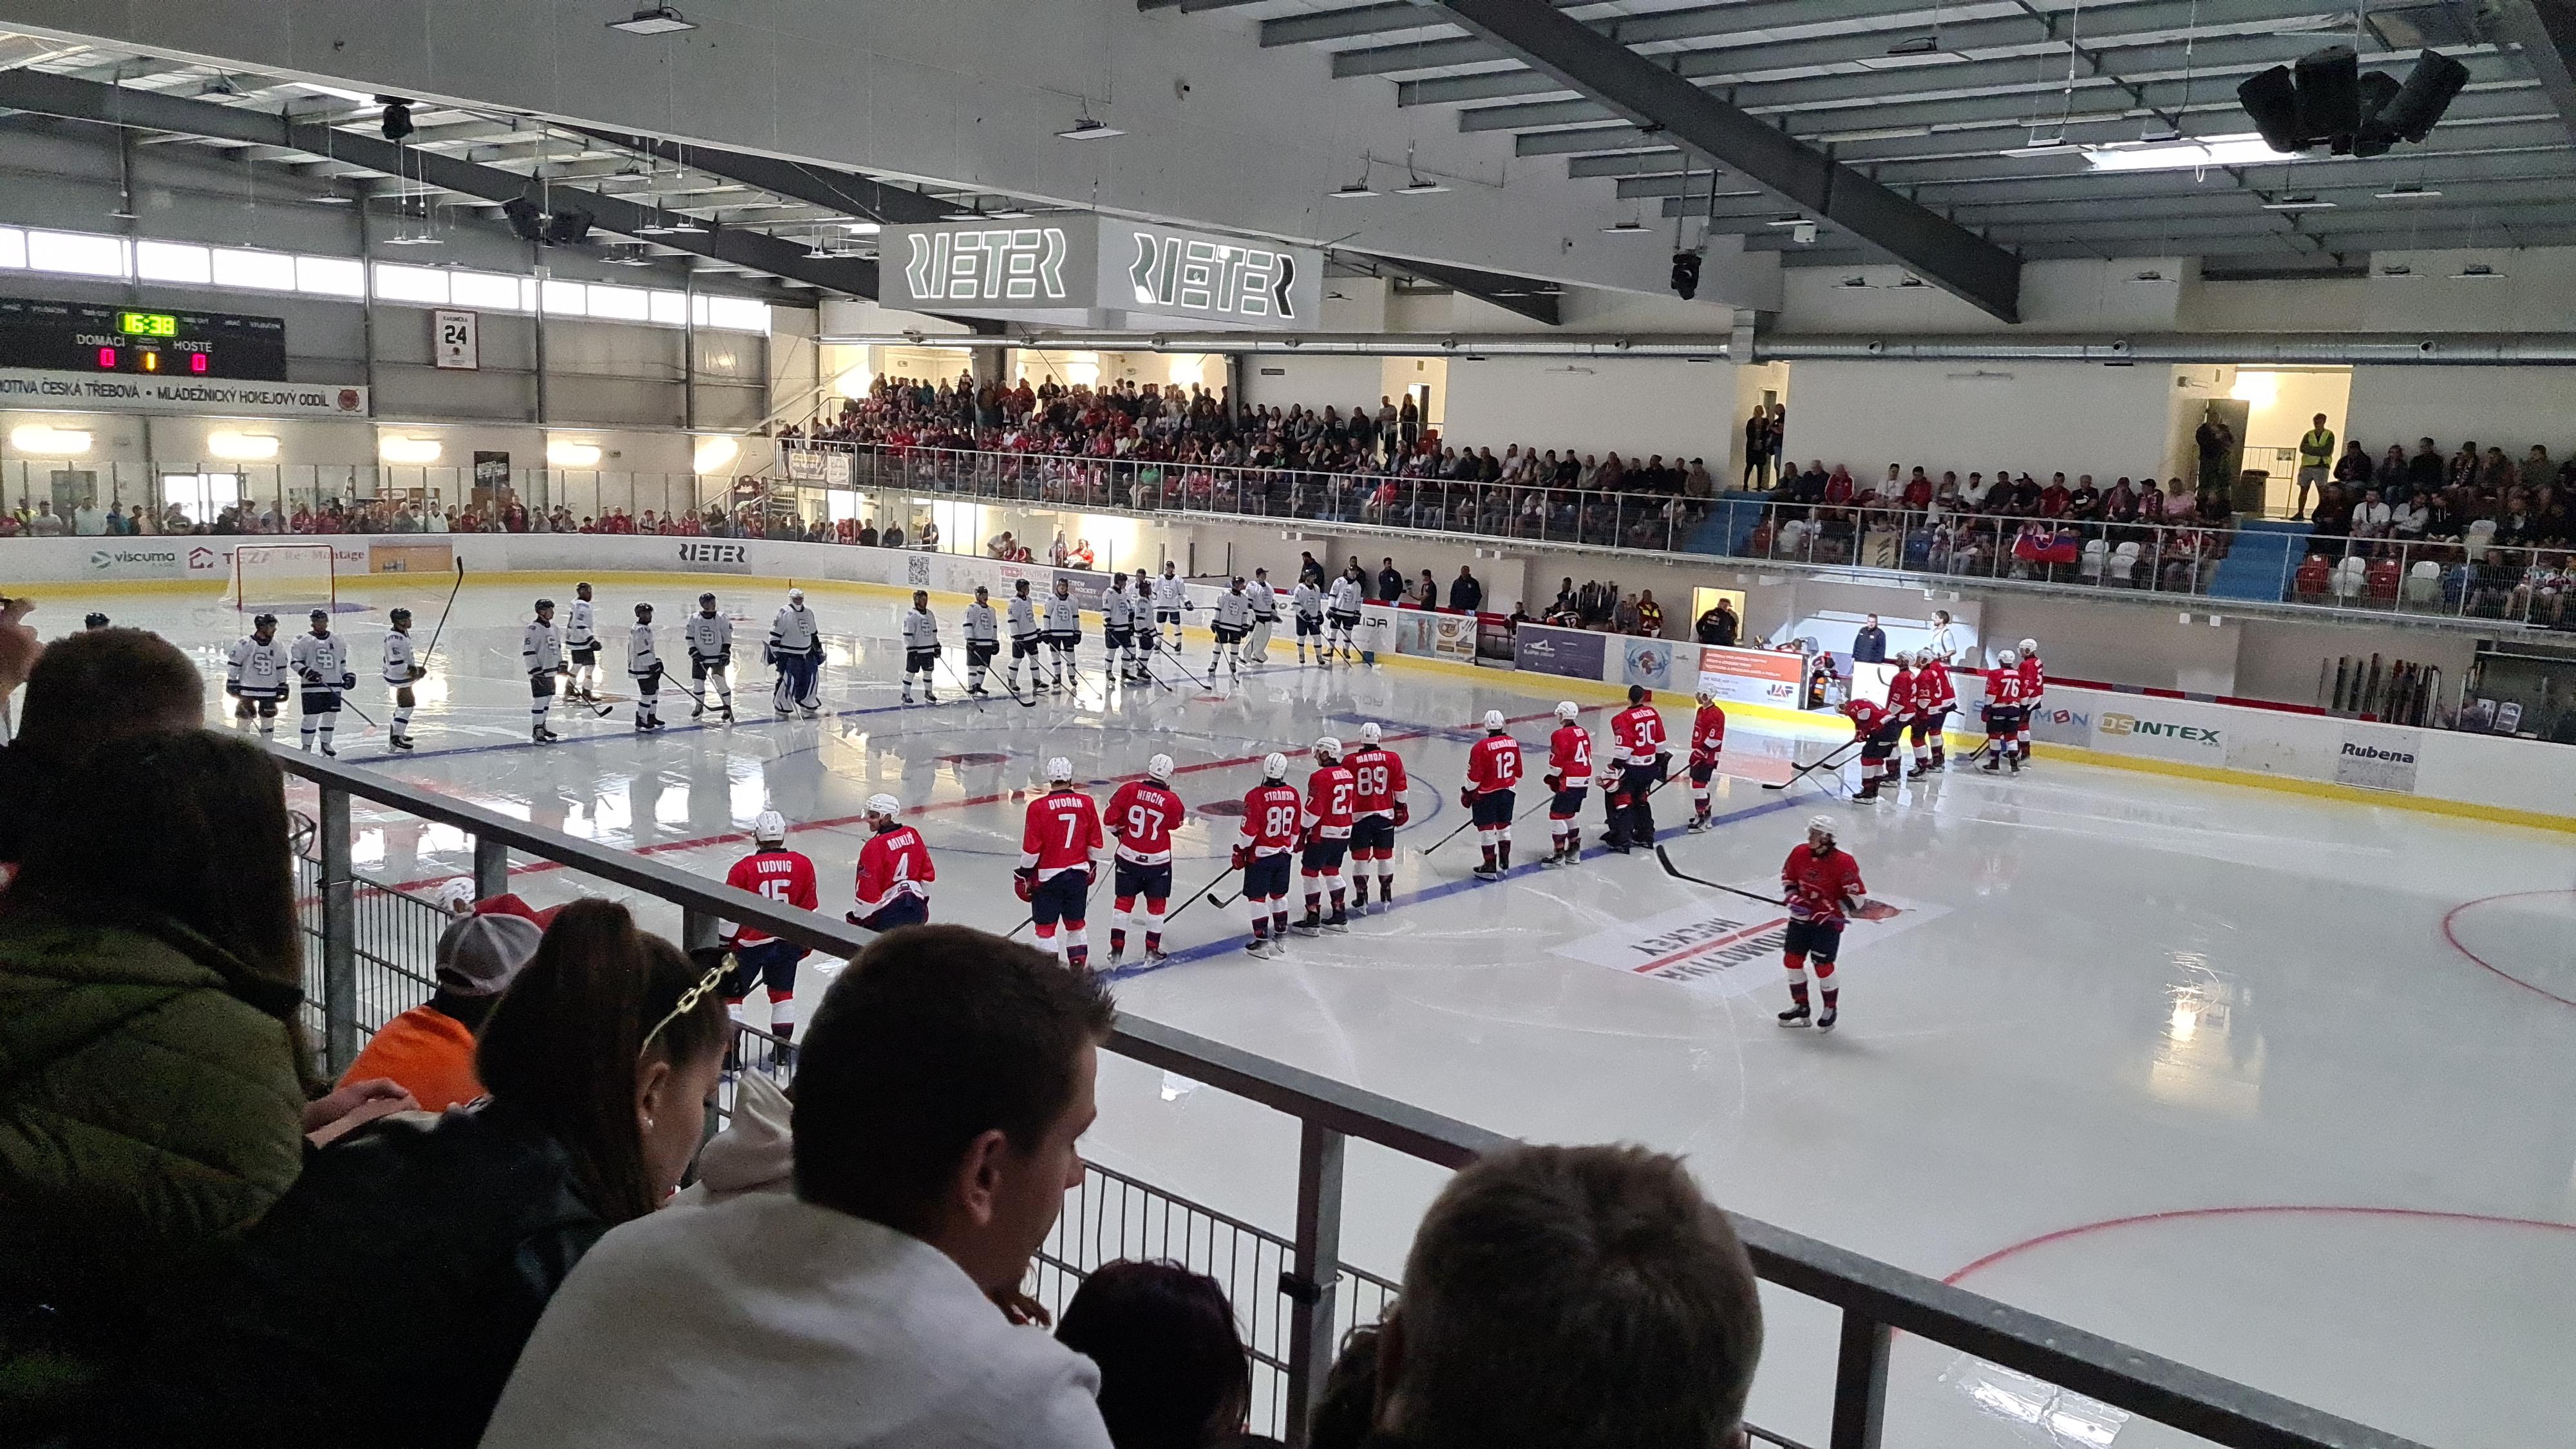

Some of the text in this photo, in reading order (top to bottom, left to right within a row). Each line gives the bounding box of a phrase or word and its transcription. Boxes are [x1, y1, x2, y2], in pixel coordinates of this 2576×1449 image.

[905, 228, 1066, 299] RIETER
[1128, 232, 1296, 319] RIETER
[124, 314, 175, 336] 16:38
[445, 325, 467, 345] 24
[77, 334, 126, 347] DOMÁCÍ
[100, 348, 208, 372] 0 1 0
[0, 379, 39, 395] OTIVA
[42, 377, 83, 395] ČESKÁ
[84, 381, 140, 399] TŘEBOVÁ
[158, 384, 236, 402] MLÁDEŽNICKÝ
[240, 389, 296, 405] HOKEJOVÝ
[299, 390, 329, 407] ODDÍL
[115, 551, 175, 562] viscuma
[679, 543, 745, 563] RIETER
[1766, 684, 1794, 698] JAF
[2000, 677, 2021, 697] 76
[1634, 719, 1656, 747] 30
[1495, 752, 1515, 779] 12
[2341, 743, 2414, 764] Rubena
[1358, 766, 1388, 796] 89
[1332, 783, 1354, 815] 27
[1058, 813, 1077, 849] 7
[1128, 804, 1165, 841] 97
[1265, 806, 1296, 838] 88
[757, 860, 793, 873] LUDVIG
[892, 852, 909, 883] 4
